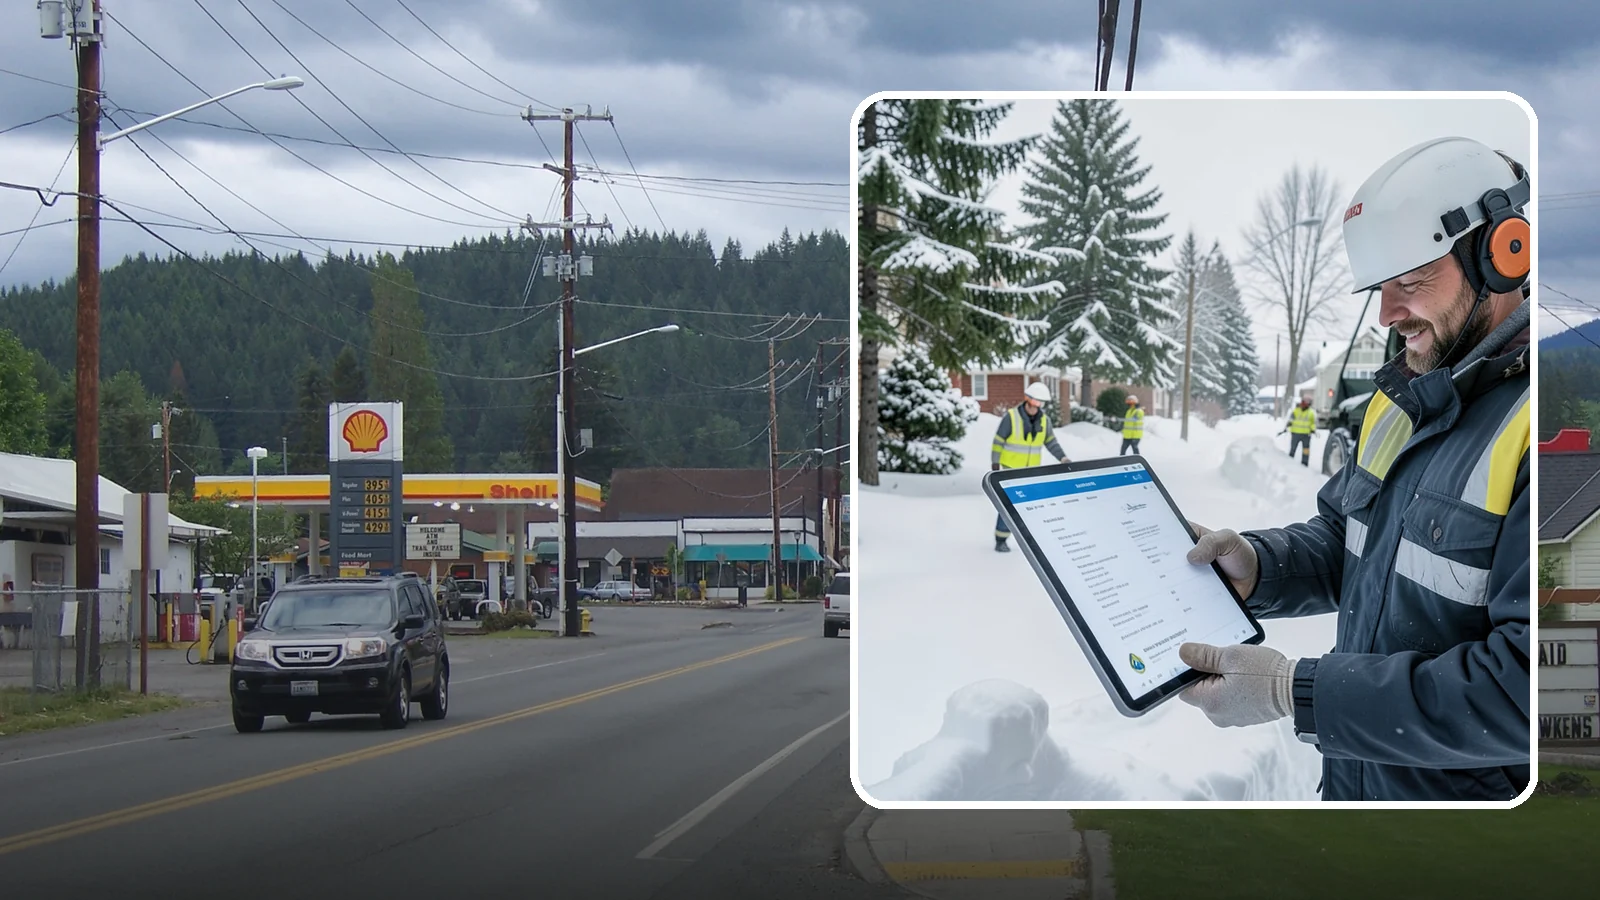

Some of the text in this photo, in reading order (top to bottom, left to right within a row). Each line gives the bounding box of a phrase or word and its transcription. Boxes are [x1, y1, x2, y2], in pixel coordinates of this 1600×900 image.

[366, 480, 384, 490] 395
[490, 484, 548, 499] Shell
[366, 494, 384, 504] 405
[366, 508, 384, 518] 415
[366, 522, 384, 532] 429
